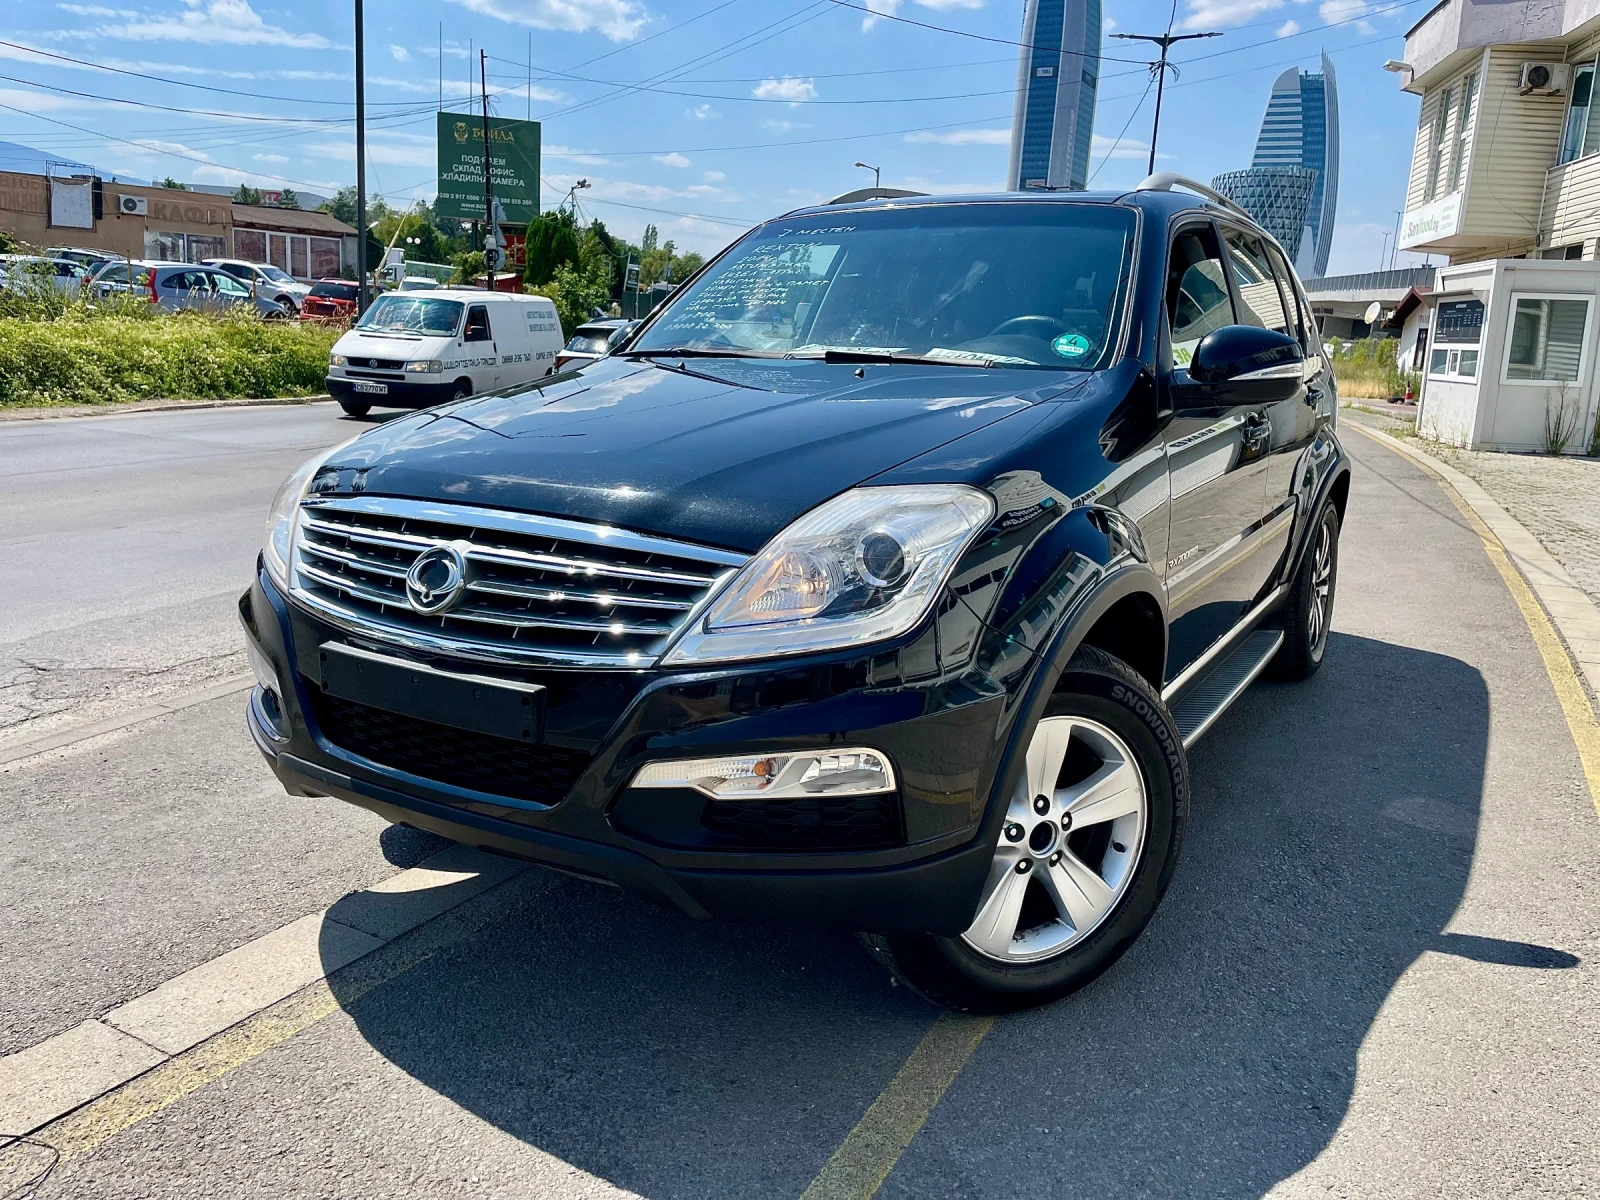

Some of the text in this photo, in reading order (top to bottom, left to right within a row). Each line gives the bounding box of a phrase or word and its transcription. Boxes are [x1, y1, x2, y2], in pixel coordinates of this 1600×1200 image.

[461, 155, 480, 164] ПОД
[452, 164, 514, 176] СКЛАД ОФИС
[490, 178, 525, 187] КАМЕРА
[153, 203, 217, 223] КАФЕ
[796, 226, 856, 235] МЕСТЕН
[751, 241, 823, 254] REXTON
[1068, 335, 1078, 346] 4
[1111, 685, 1185, 818] SNOWDRAGON
